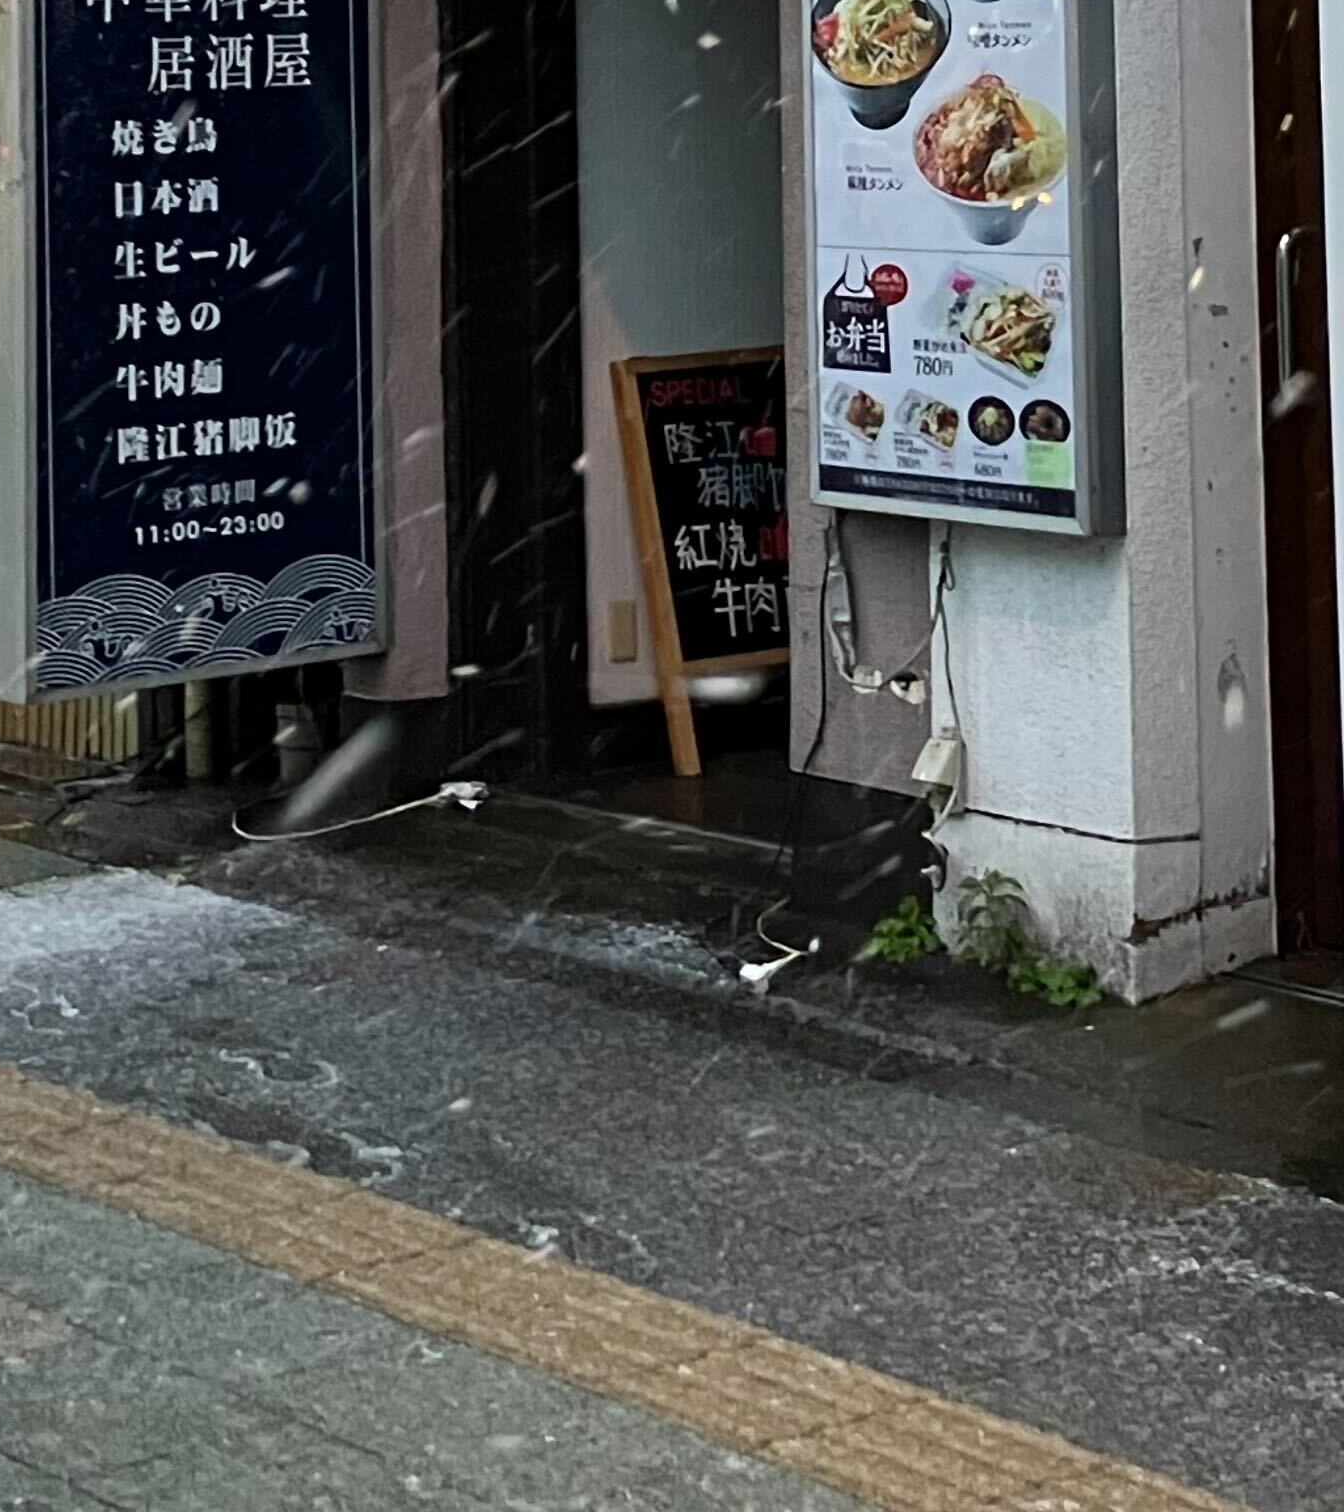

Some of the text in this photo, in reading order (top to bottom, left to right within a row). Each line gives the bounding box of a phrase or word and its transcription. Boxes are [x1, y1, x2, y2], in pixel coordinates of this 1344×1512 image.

[148, 32, 312, 93] 居酒屋
[111, 119, 219, 156] 焼き鳥
[112, 178, 219, 218] 日本酒
[113, 236, 258, 280] 生ビール
[115, 299, 222, 340] 丼もの
[826, 316, 886, 353] お弁当
